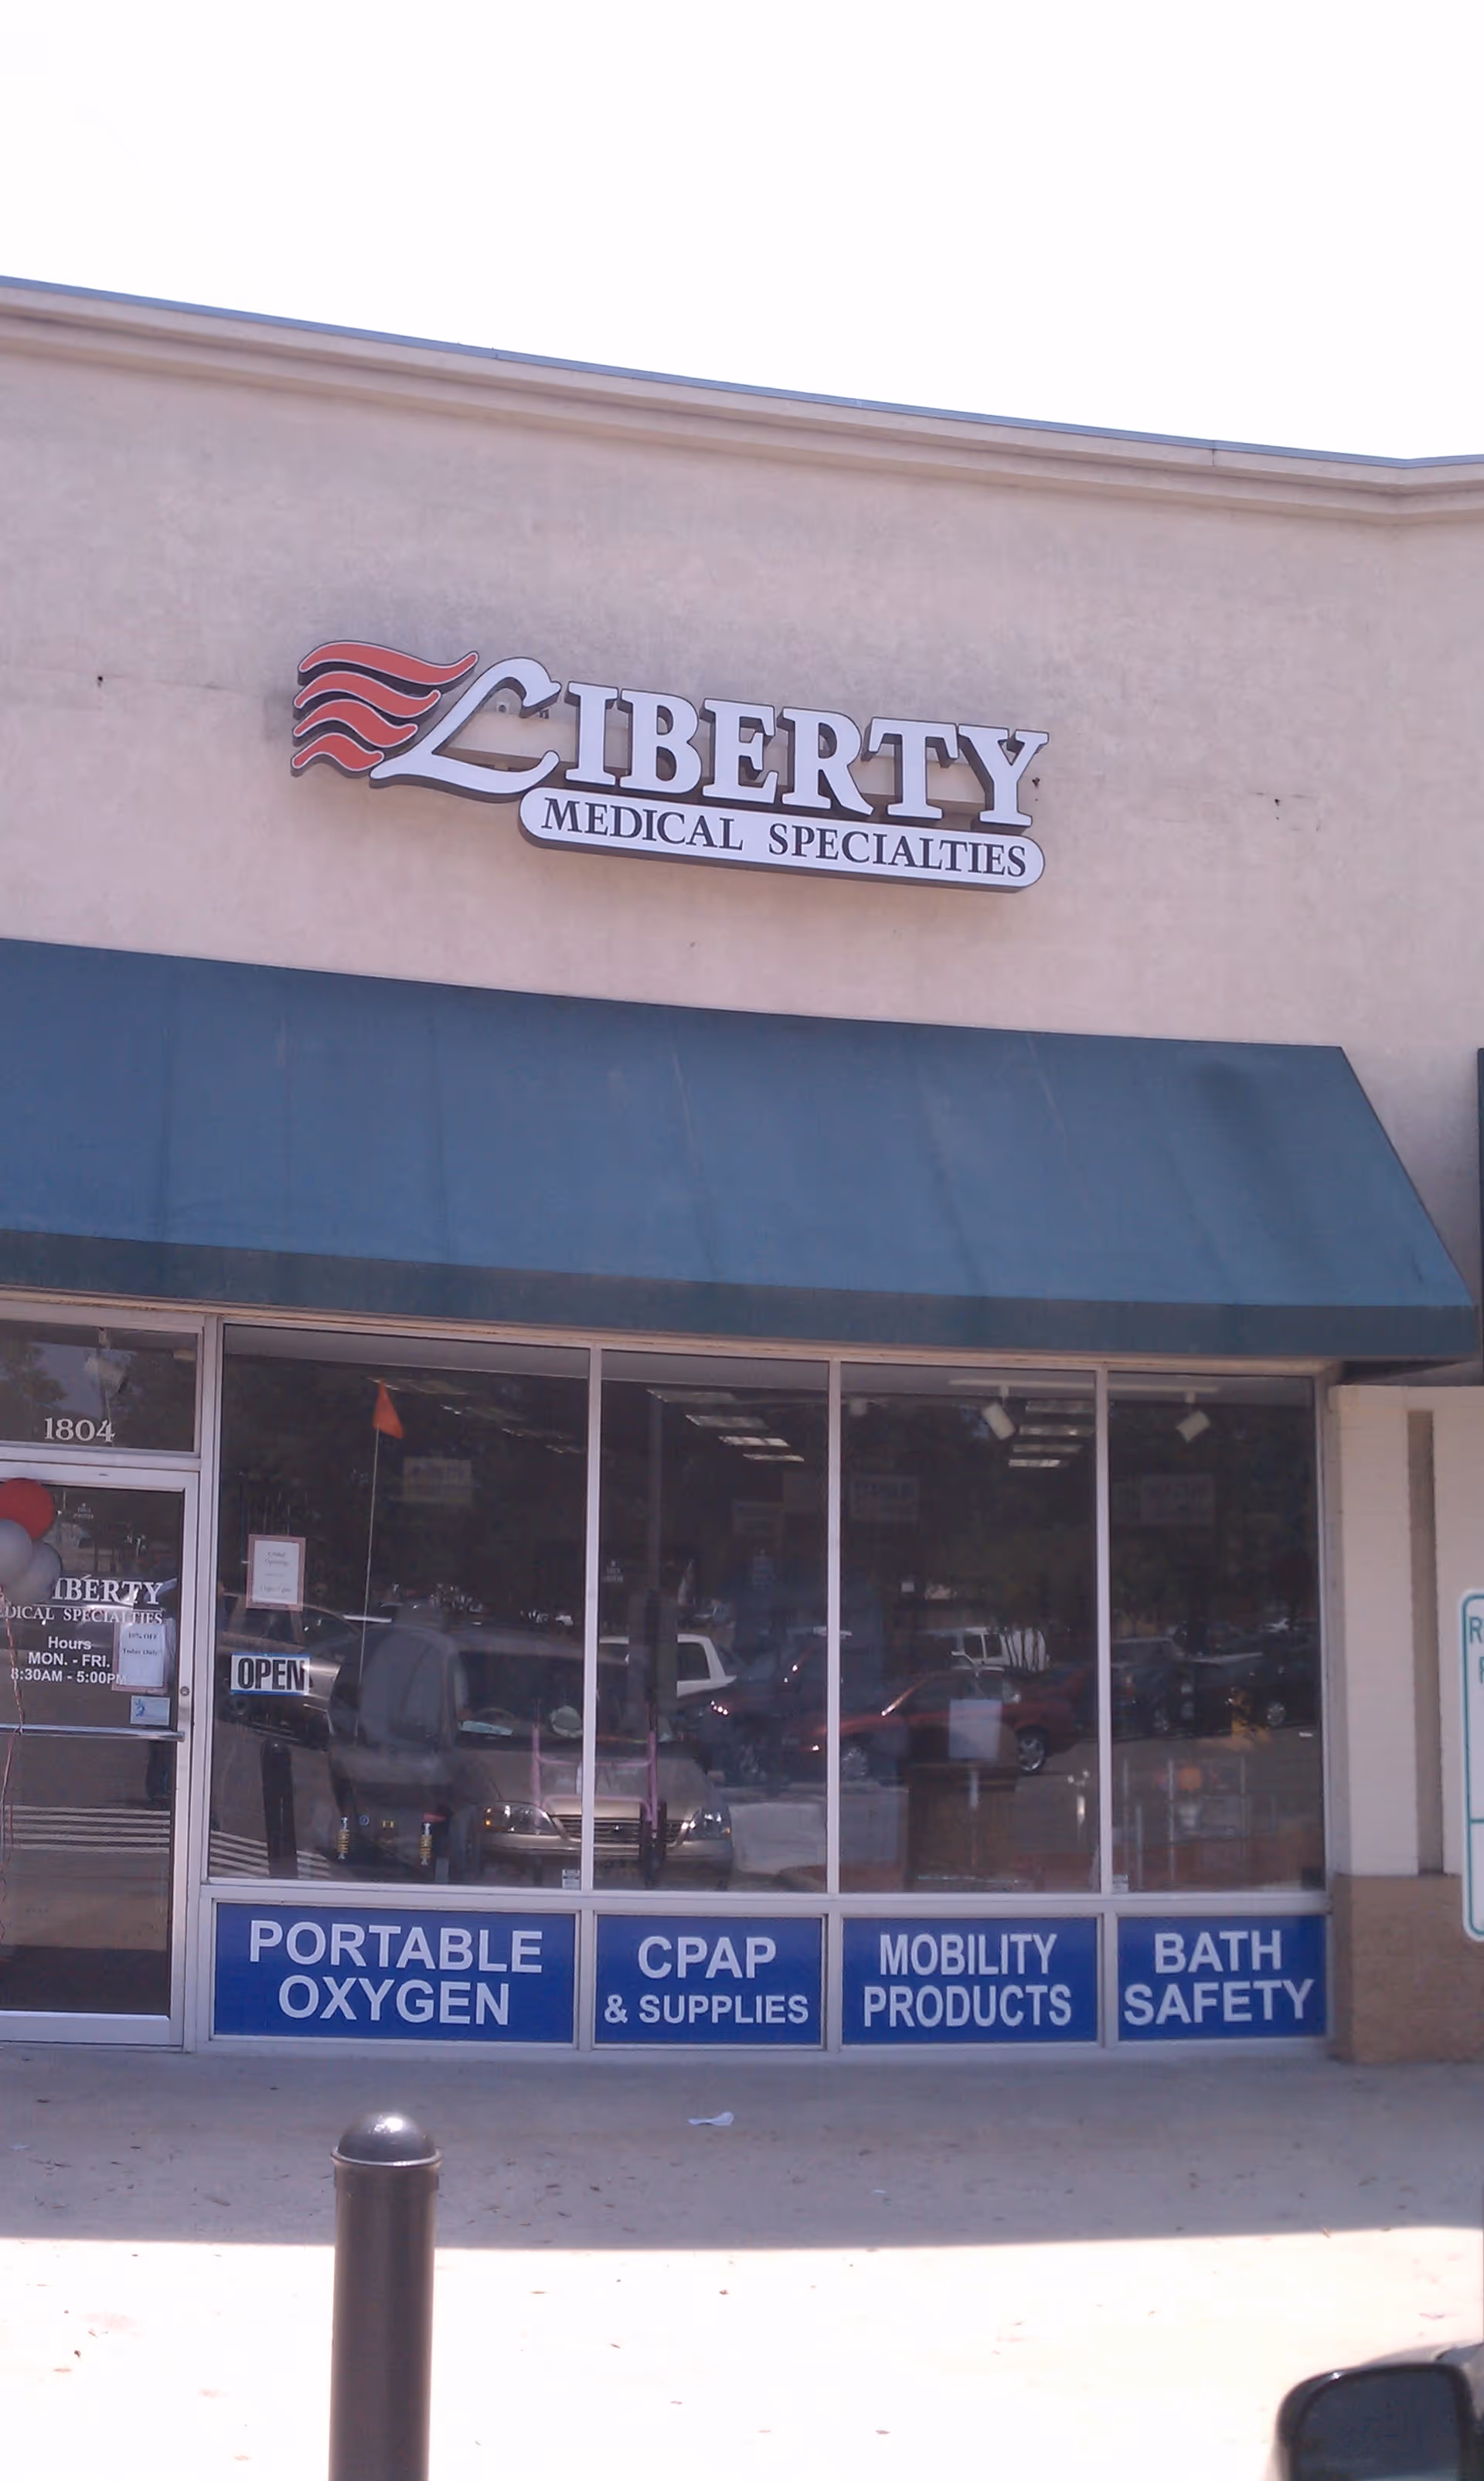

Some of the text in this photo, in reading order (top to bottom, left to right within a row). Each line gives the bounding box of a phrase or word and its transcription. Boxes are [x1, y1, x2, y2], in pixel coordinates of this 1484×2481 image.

[371, 656, 1049, 826] LIBERTY
[540, 796, 1028, 878] MEDICAL SPECIALTIES
[45, 1417, 115, 1442] 1804
[52, 1577, 163, 1605] IBERTY
[63, 1608, 163, 1625] SPECIALTIES
[28, 1652, 68, 1666] MON.
[82, 1654, 111, 1668] FRI.
[48, 1636, 92, 1650] Hours
[11, 1667, 63, 1682] 8:30AM
[77, 1670, 127, 1685] 5:00PM
[237, 1657, 305, 1690] OPEN
[250, 1920, 543, 1973] PORTABLE
[637, 1935, 777, 1980] CPAP
[879, 1933, 1057, 1976] MOBILITY
[1154, 1929, 1283, 1975] BATH
[279, 1975, 509, 2026] OXYGEN
[604, 1994, 809, 2024] & SUPPLIES
[863, 1983, 1072, 2028] PRODUCTS
[1124, 1978, 1314, 2026] SAFETY
